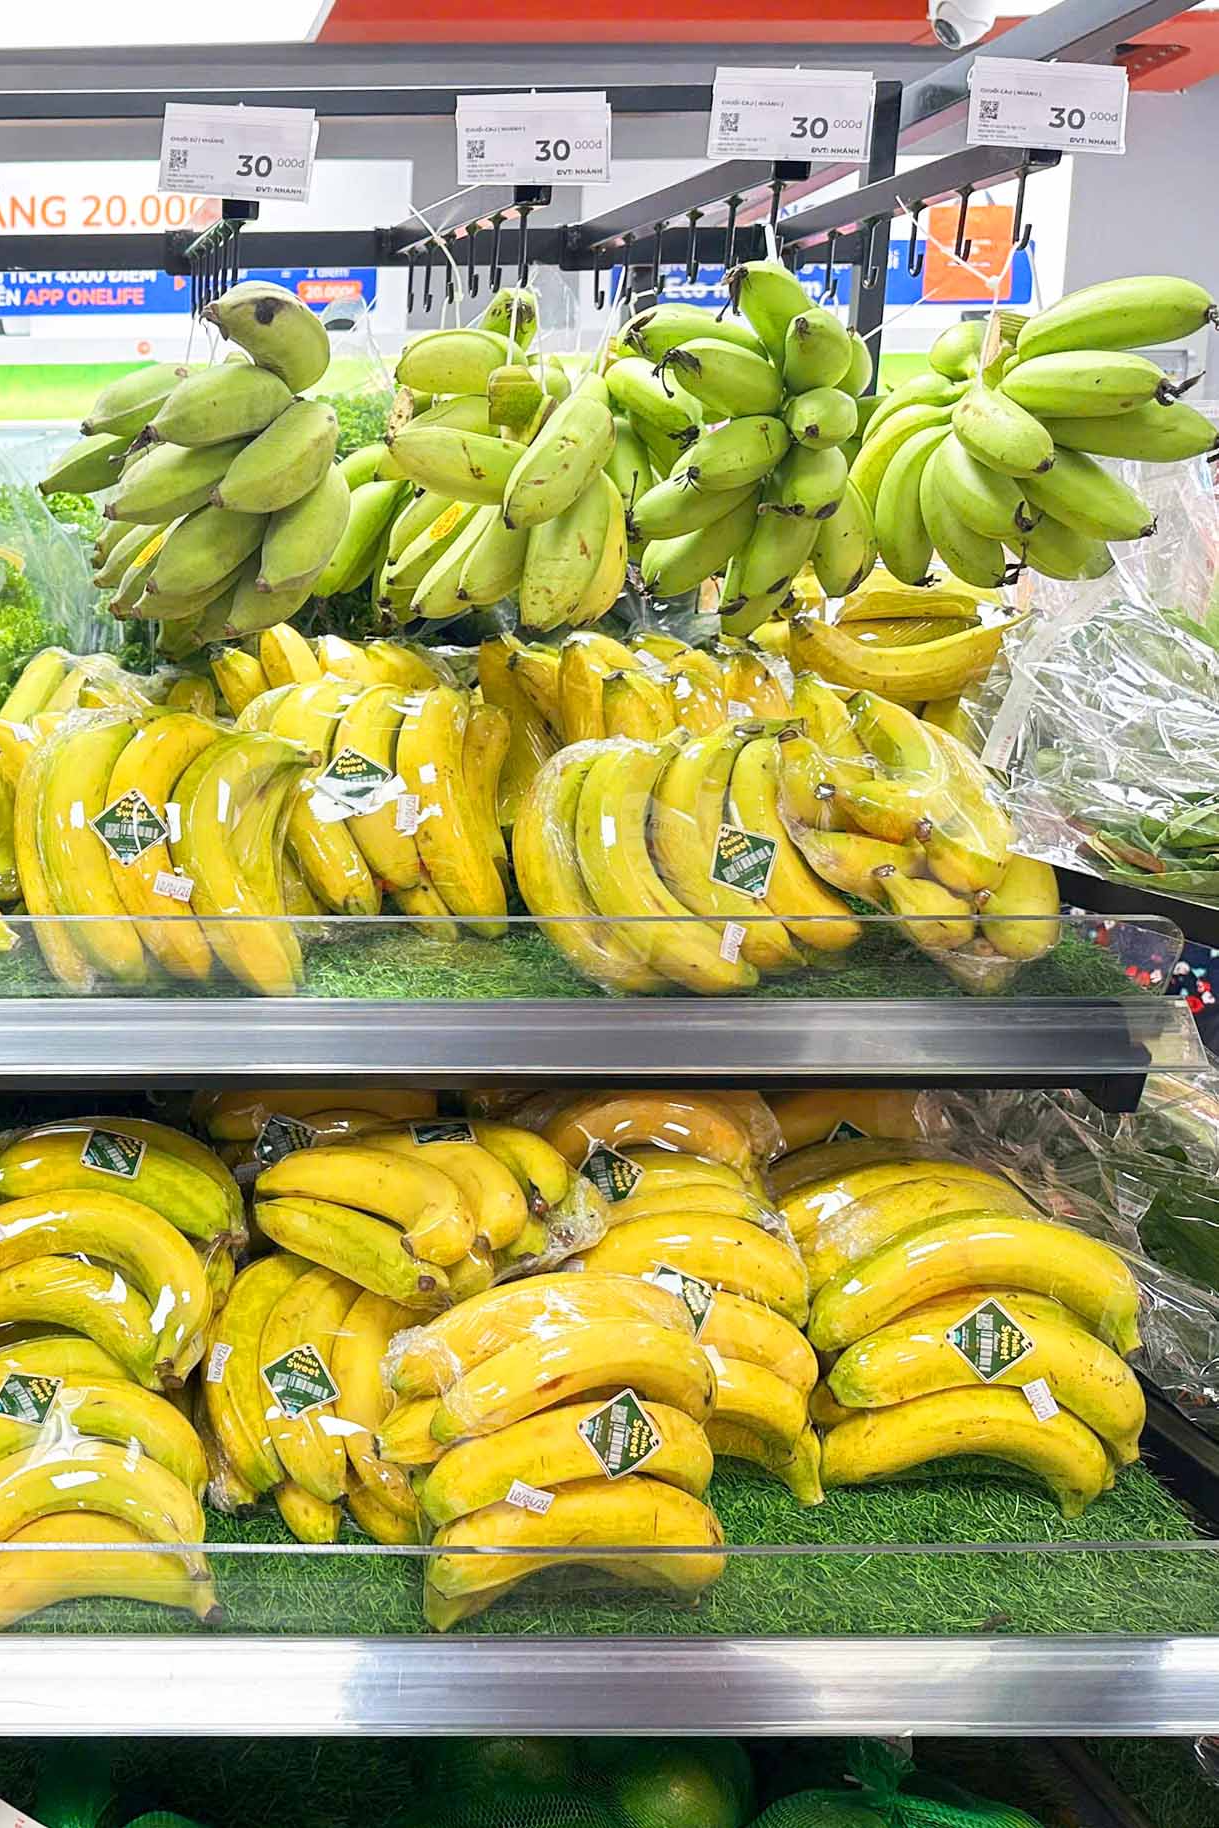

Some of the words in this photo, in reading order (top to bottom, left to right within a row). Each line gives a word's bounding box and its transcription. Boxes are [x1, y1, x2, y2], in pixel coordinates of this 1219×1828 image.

[790, 116, 829, 139] 30
[1048, 107, 1085, 130] 30
[535, 139, 570, 162] 30
[236, 154, 272, 178] 30
[24, 288, 64, 306] APP
[67, 287, 145, 306] ONELIFE
[335, 763, 367, 775] Sweet
[720, 838, 751, 860] Sweet
[999, 1324, 1012, 1362] Sweet
[1011, 1329, 1021, 1358] Pleiku
[286, 1357, 321, 1378] Sweet
[293, 1351, 319, 1368] Pleiku
[629, 1418, 644, 1458] Sweet
[639, 1425, 649, 1456] Pleiku
